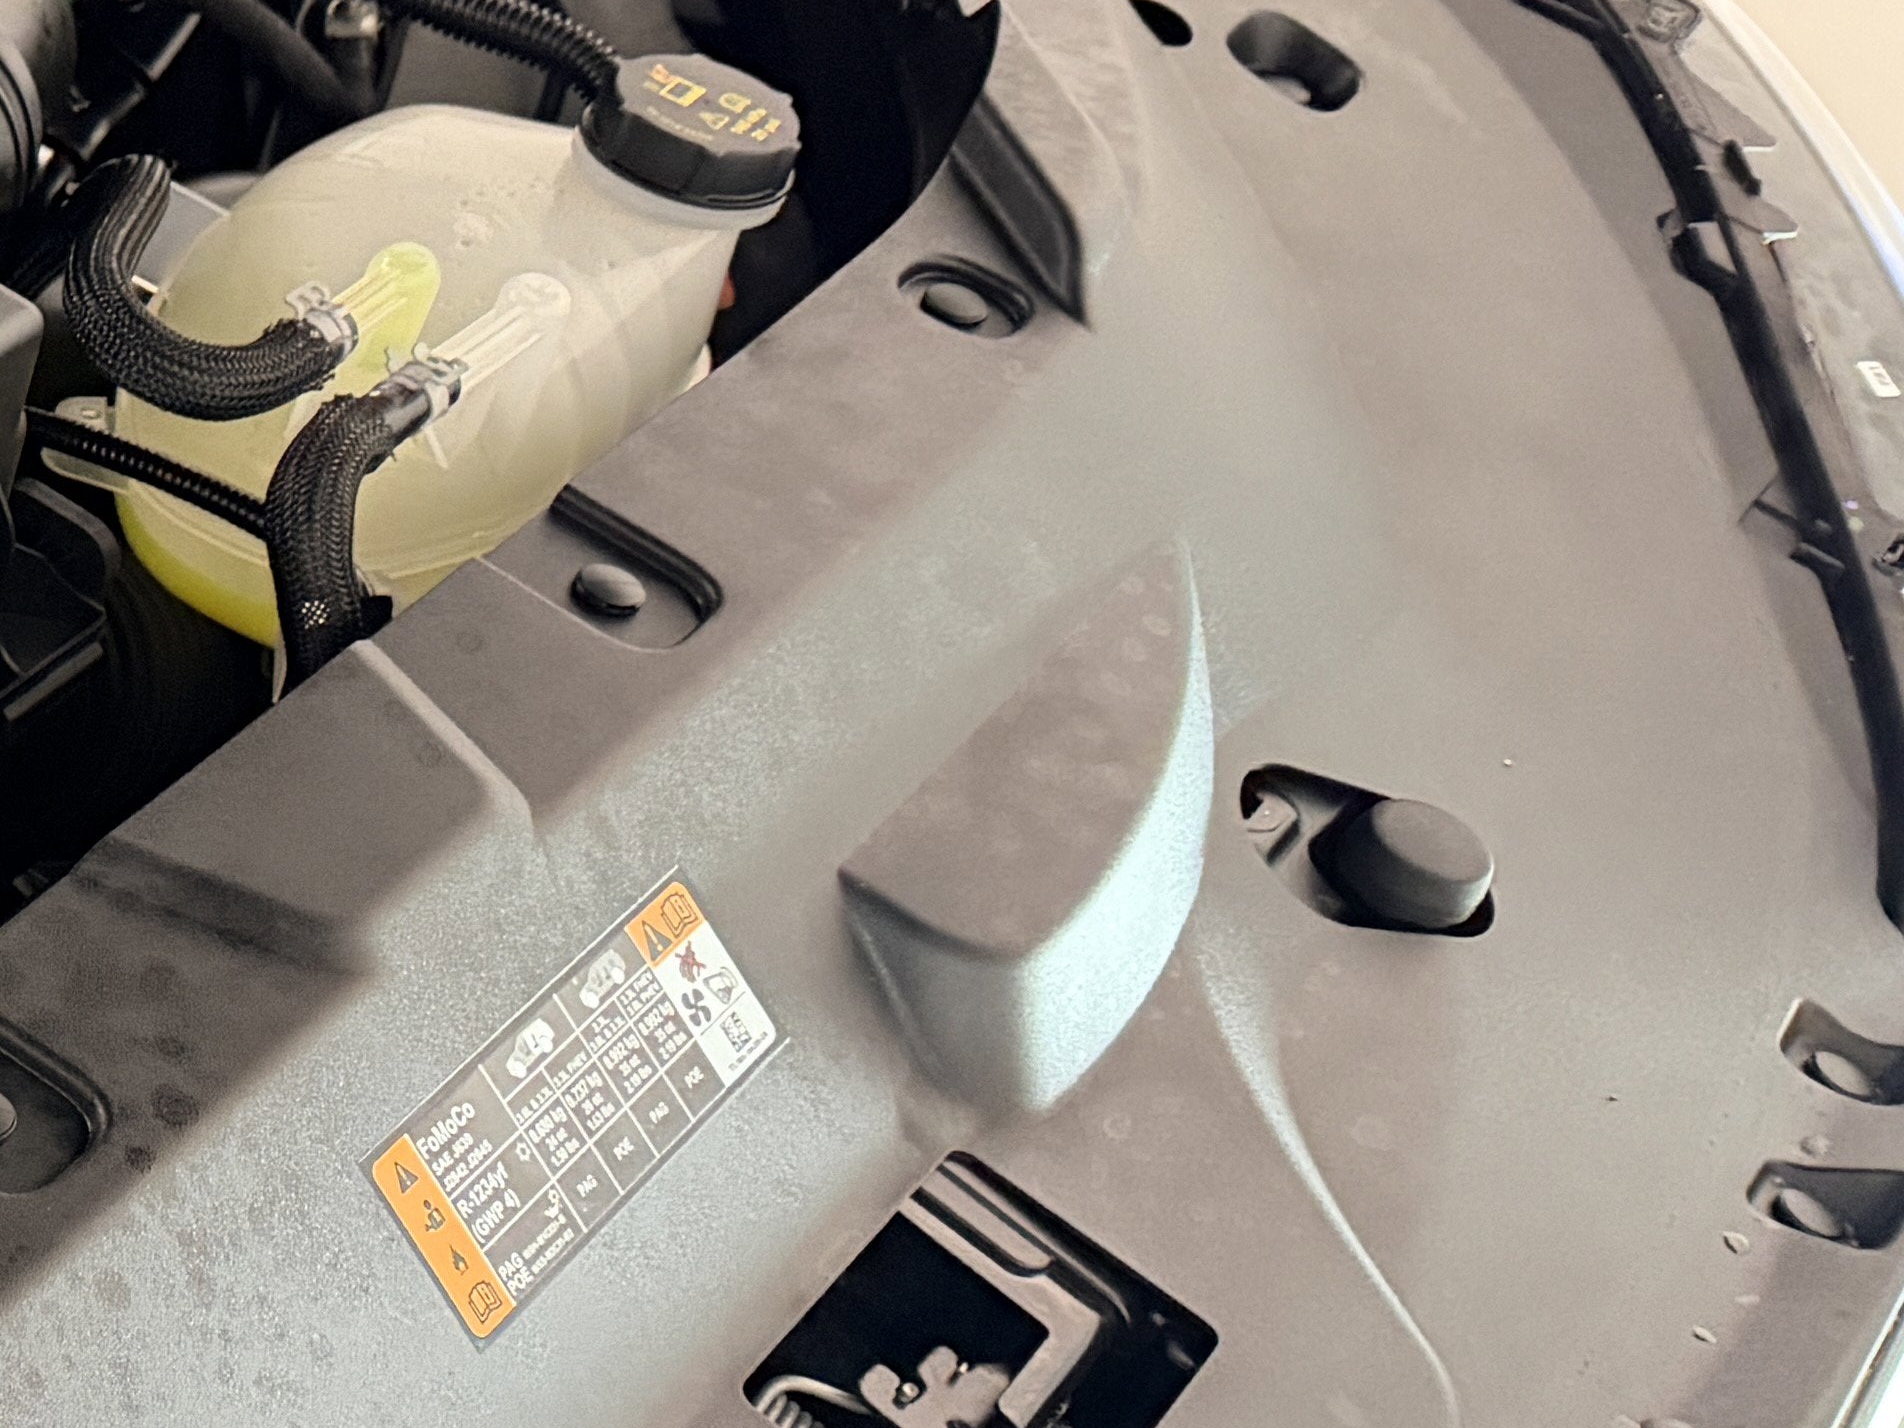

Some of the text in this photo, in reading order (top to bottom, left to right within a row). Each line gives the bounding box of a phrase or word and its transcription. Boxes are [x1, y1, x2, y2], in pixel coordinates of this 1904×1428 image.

[684, 1066, 704, 1088] POE
[649, 1101, 668, 1123] PAG
[416, 1102, 475, 1159] FoMoCo
[613, 1136, 634, 1160] POE
[456, 1161, 508, 1218] R-1234yf
[576, 1174, 597, 1197] PAG
[471, 1188, 520, 1243] (GWP 4)
[498, 1252, 523, 1281] PAG
[507, 1266, 533, 1295] POE
